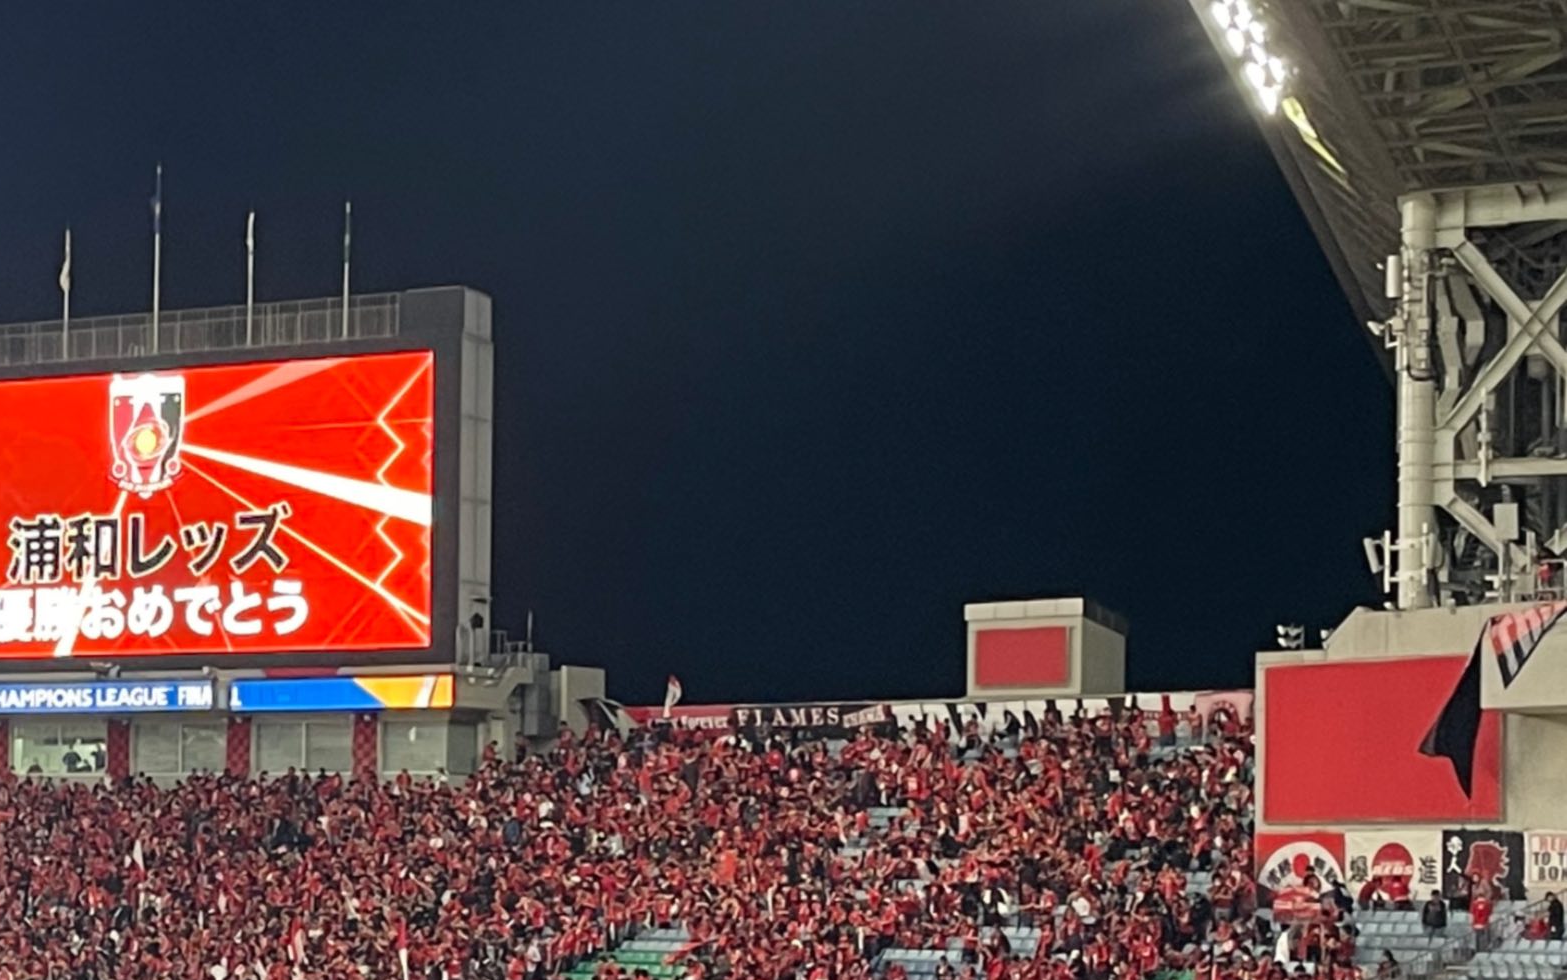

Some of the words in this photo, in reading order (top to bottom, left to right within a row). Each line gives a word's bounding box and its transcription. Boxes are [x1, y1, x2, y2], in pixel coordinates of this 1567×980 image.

[8, 503, 292, 582] 浦和レッズ
[95, 687, 168, 707] LEAGUE
